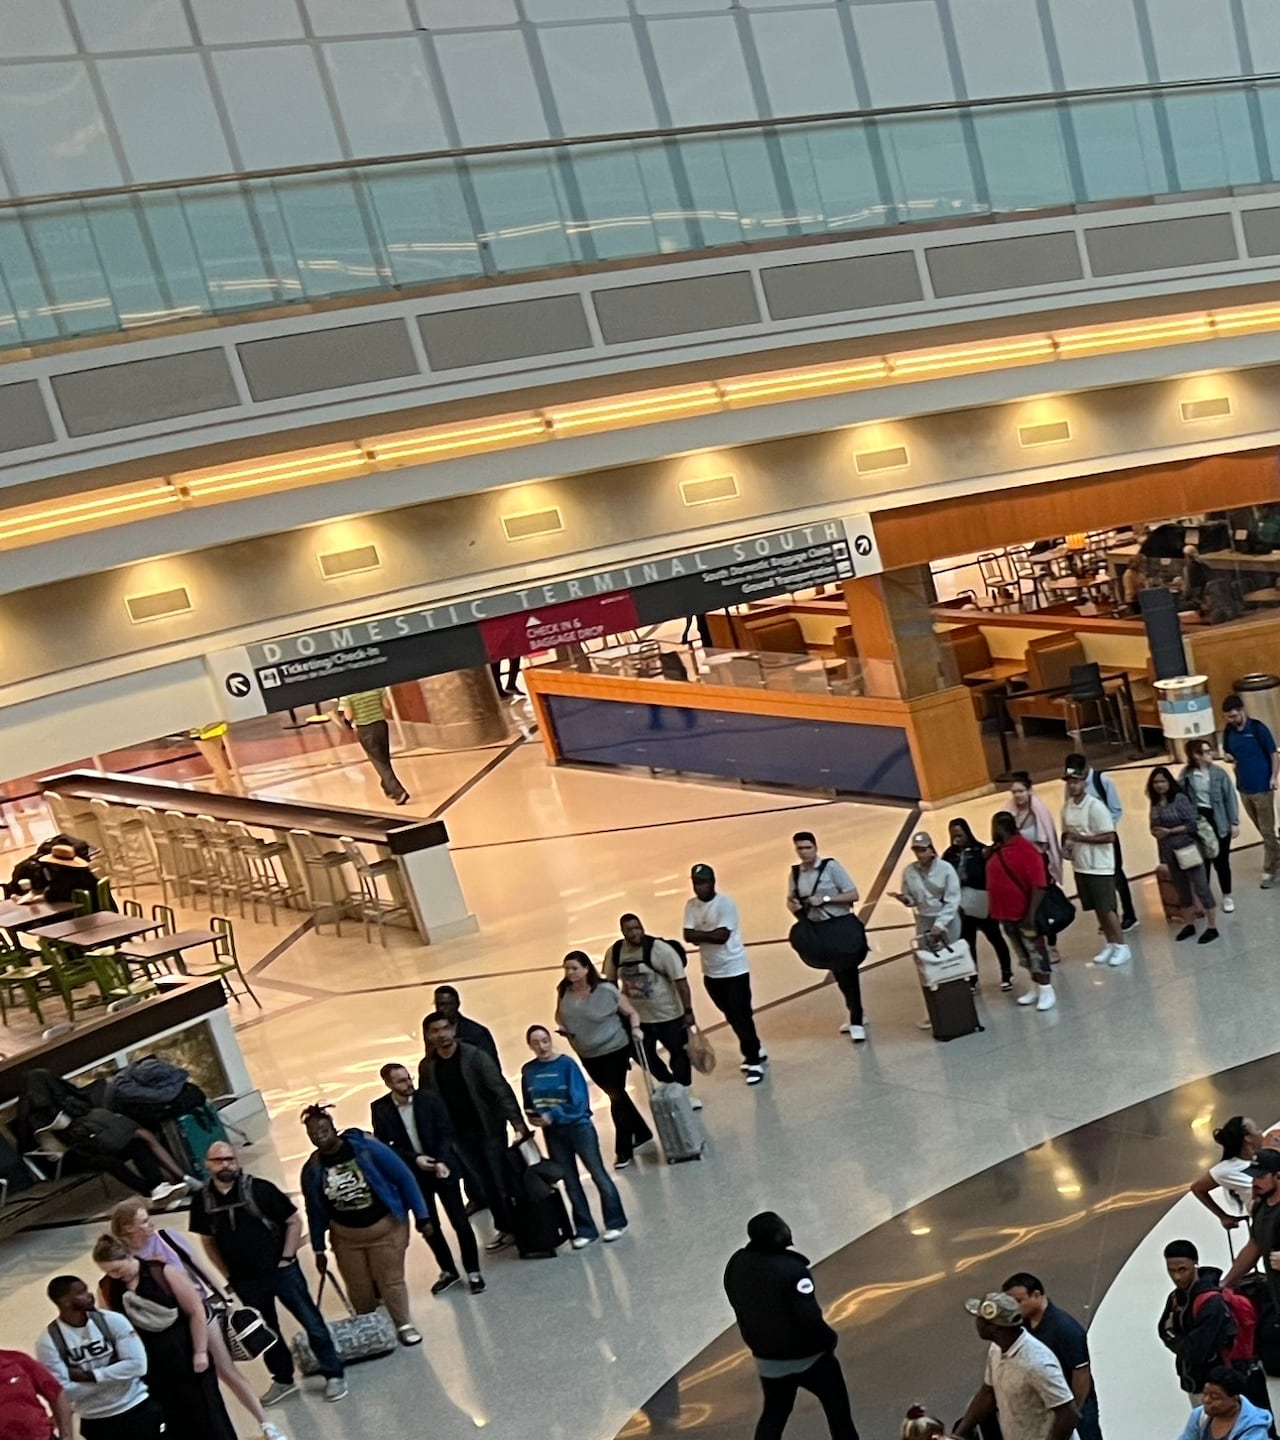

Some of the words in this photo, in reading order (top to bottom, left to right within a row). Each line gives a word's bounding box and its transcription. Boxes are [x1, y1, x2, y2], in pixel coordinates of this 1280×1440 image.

[262, 601, 487, 661] DOMESTIC
[518, 554, 709, 611] TERMINAL
[732, 522, 839, 562] SOUTH
[526, 623, 560, 638] CHECK
[529, 630, 577, 650] BAGGAGE
[577, 624, 604, 640] DROP
